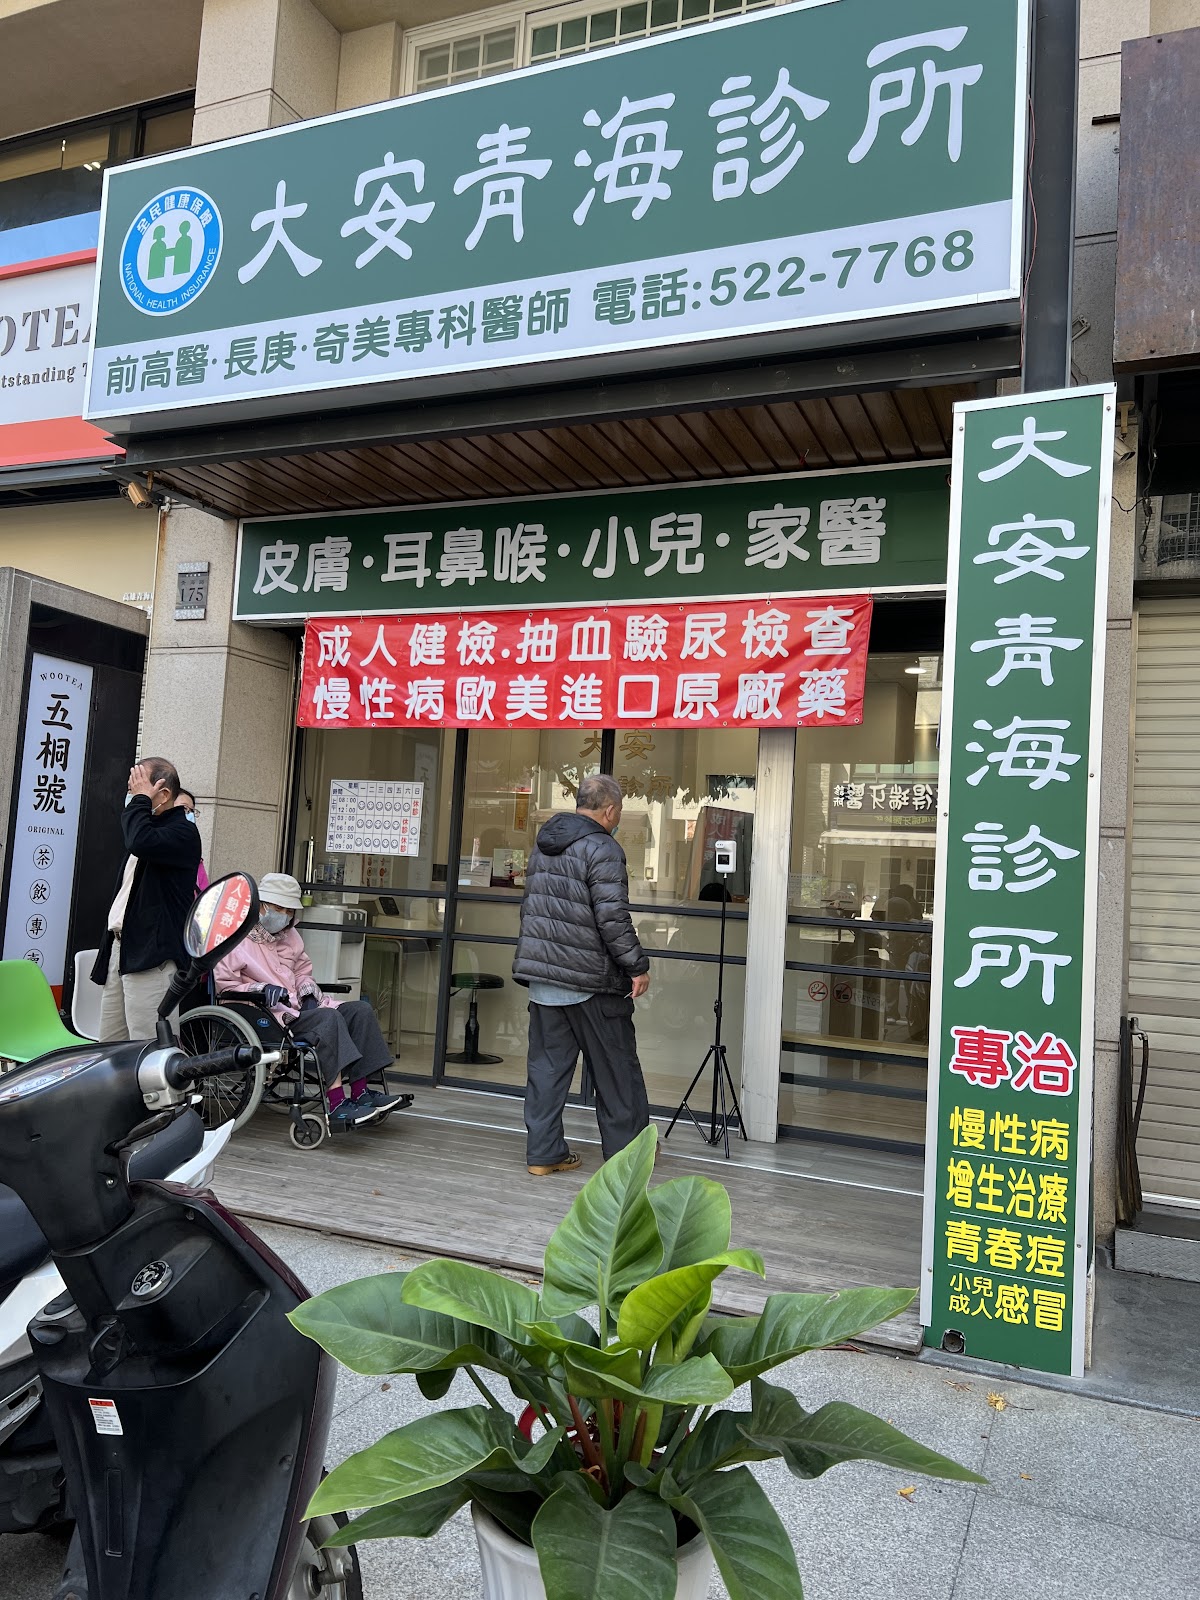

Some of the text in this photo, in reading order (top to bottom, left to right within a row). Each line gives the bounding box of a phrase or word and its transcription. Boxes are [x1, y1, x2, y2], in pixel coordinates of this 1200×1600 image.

[237, 25, 984, 285] 大安青海診所
[137, 193, 212, 235] 全民健康保險
[125, 247, 217, 309] NATIONAL HEALTH INSURANCE
[180, 587, 204, 602] 175
[40, 672, 83, 691] WOOTEA
[313, 668, 849, 721] 慢性病歐美進口原廠藥
[954, 416, 1092, 1006] 大安青海診所
[33, 693, 73, 814] 五桐號
[579, 729, 656, 760] 大安
[412, 800, 420, 816] 休診
[414, 787, 420, 795] 日
[27, 825, 65, 836] ORIGINAL
[401, 818, 409, 834] 休診
[400, 837, 408, 853] 休診
[950, 1026, 1076, 1096] 專治
[949, 1106, 1070, 1161] 慢性病
[945, 1220, 1066, 1278] 青春痘
[949, 1273, 993, 1298] 小兒
[948, 1294, 993, 1320] 成人
[994, 1284, 1066, 1332] 感冒
